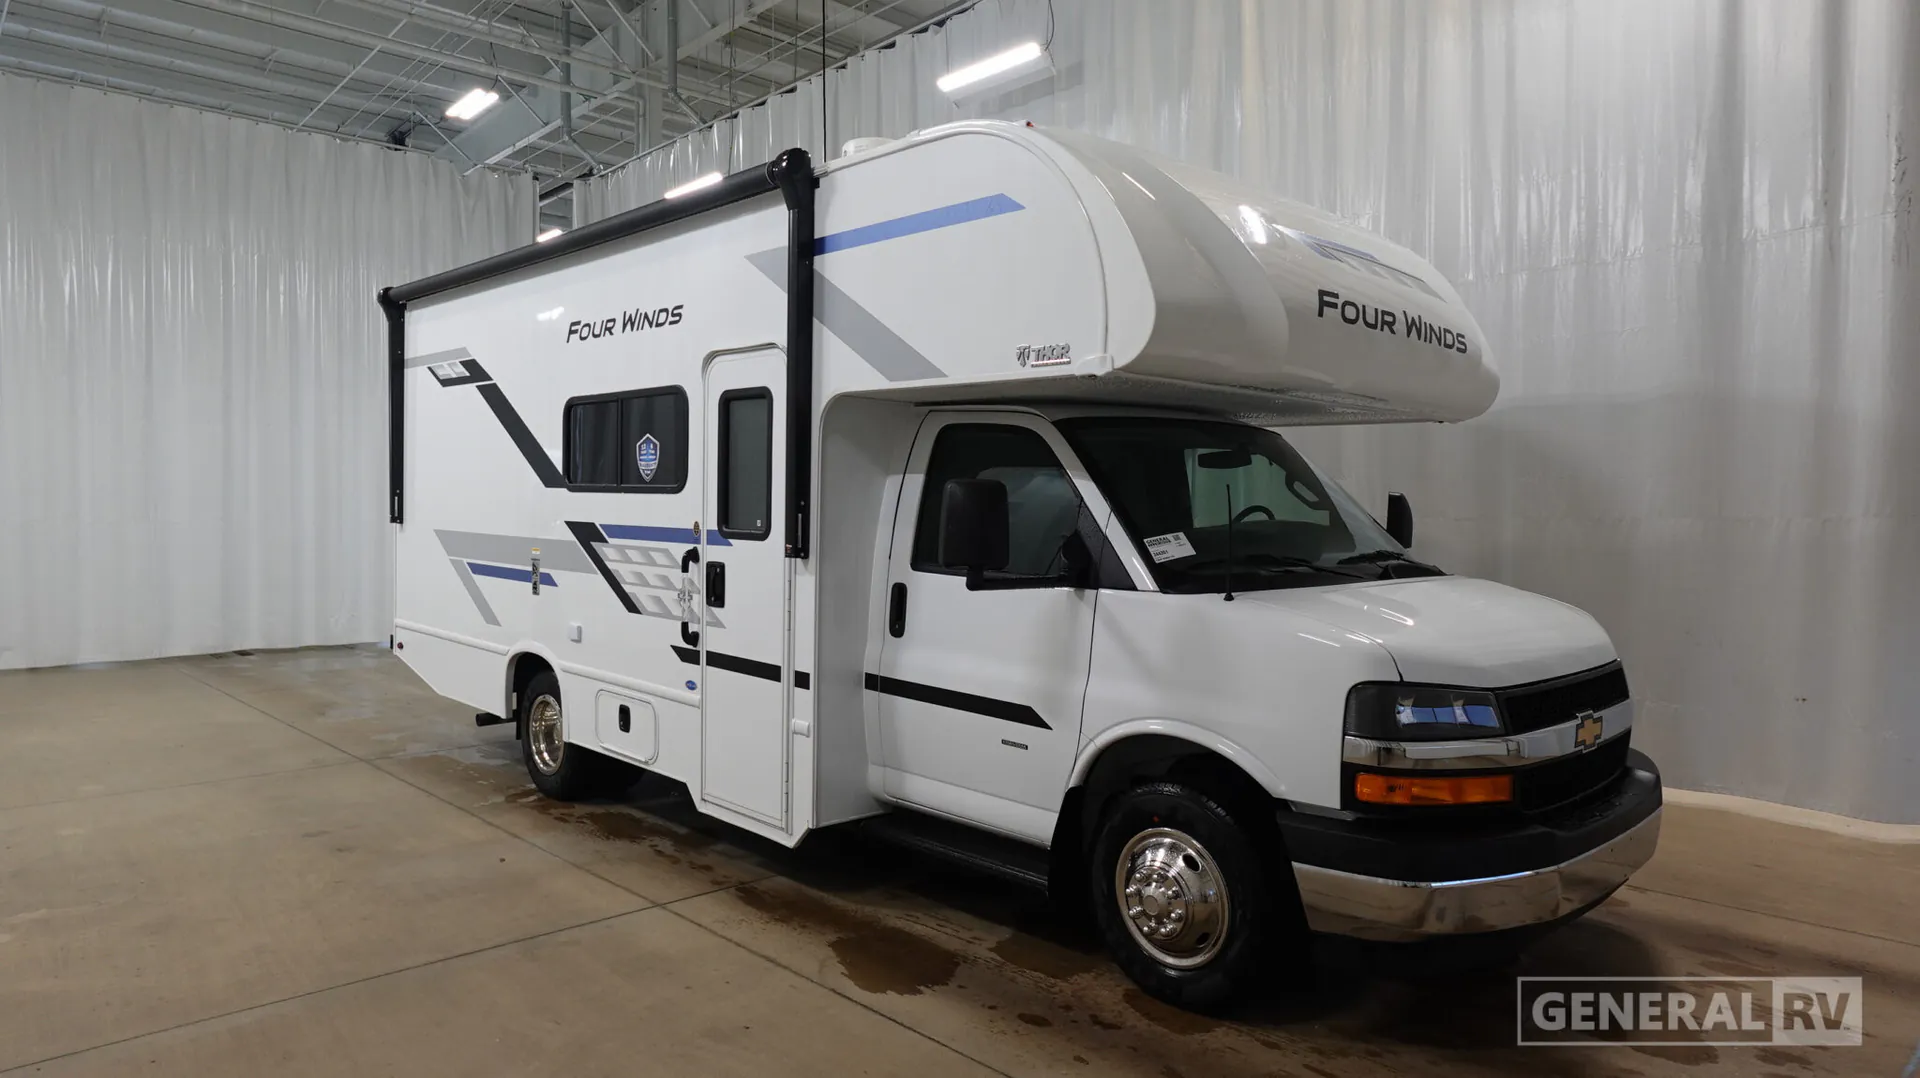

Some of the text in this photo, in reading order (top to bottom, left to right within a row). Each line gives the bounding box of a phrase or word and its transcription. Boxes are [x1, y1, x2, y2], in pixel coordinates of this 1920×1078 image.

[566, 304, 684, 344] FOUR WINDS
[1317, 289, 1468, 354] FOUR WINDS
[1031, 343, 1071, 362] THOR
